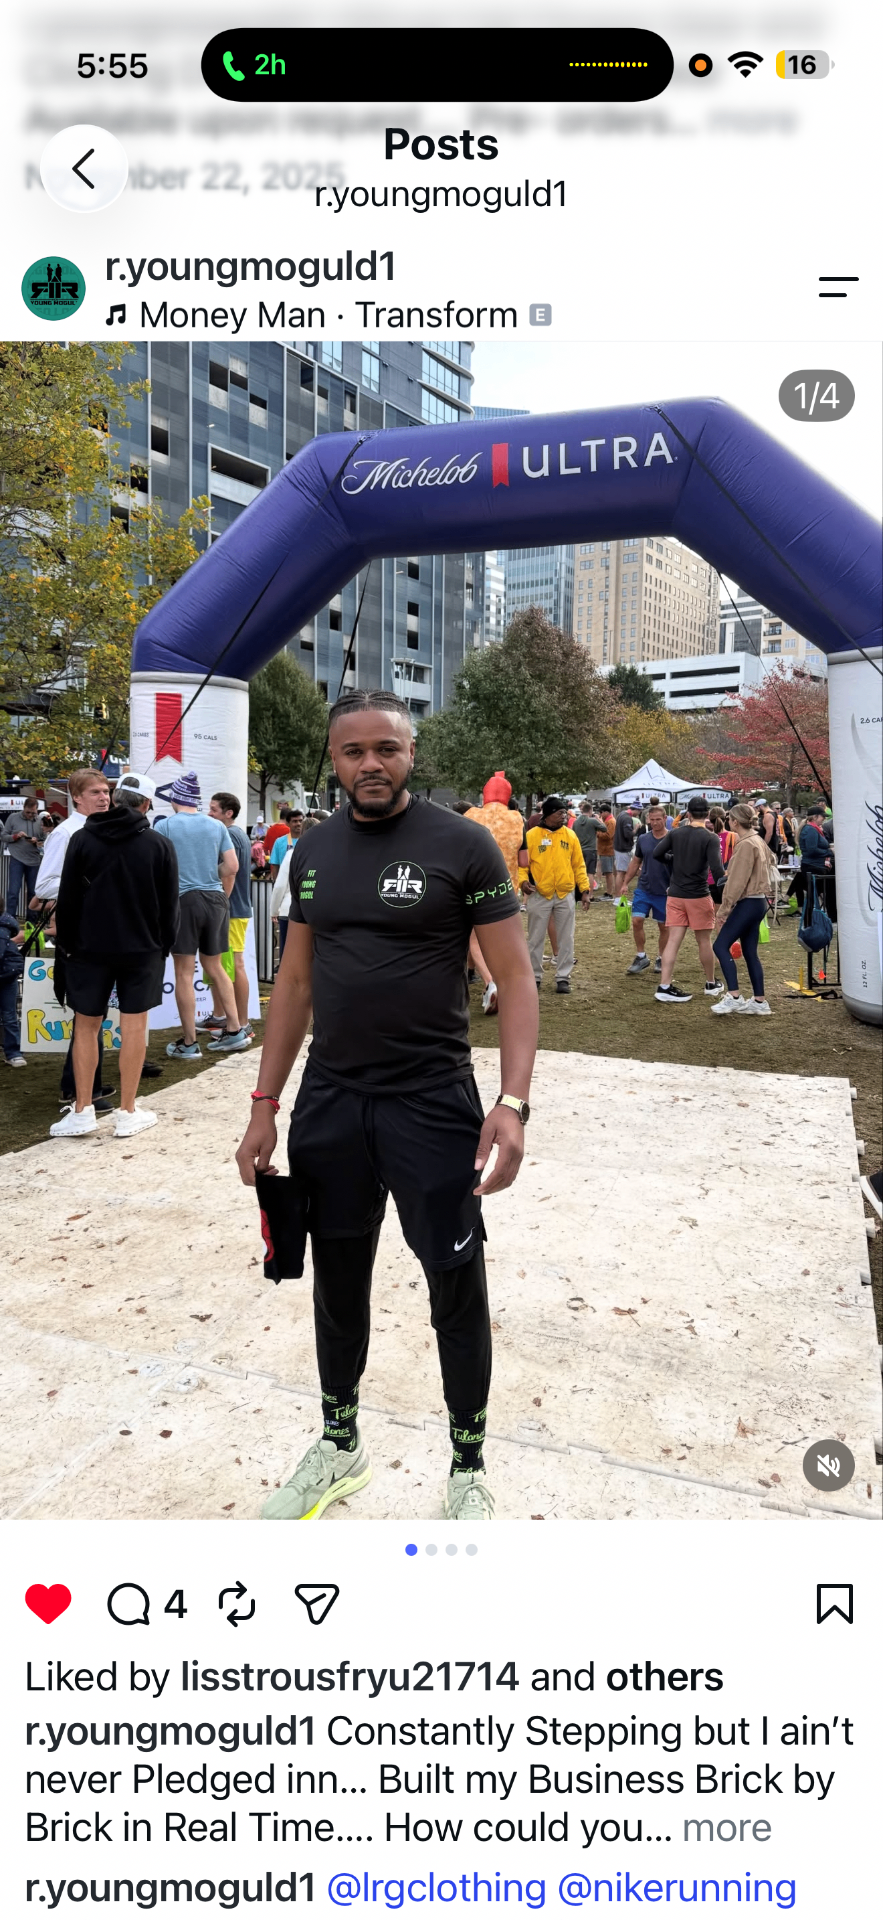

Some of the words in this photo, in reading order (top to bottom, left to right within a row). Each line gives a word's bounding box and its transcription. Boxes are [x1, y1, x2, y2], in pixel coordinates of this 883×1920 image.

[341, 452, 483, 495] Michelob
[522, 432, 674, 479] ULTRA
[707, 792, 730, 800] ULTRA
